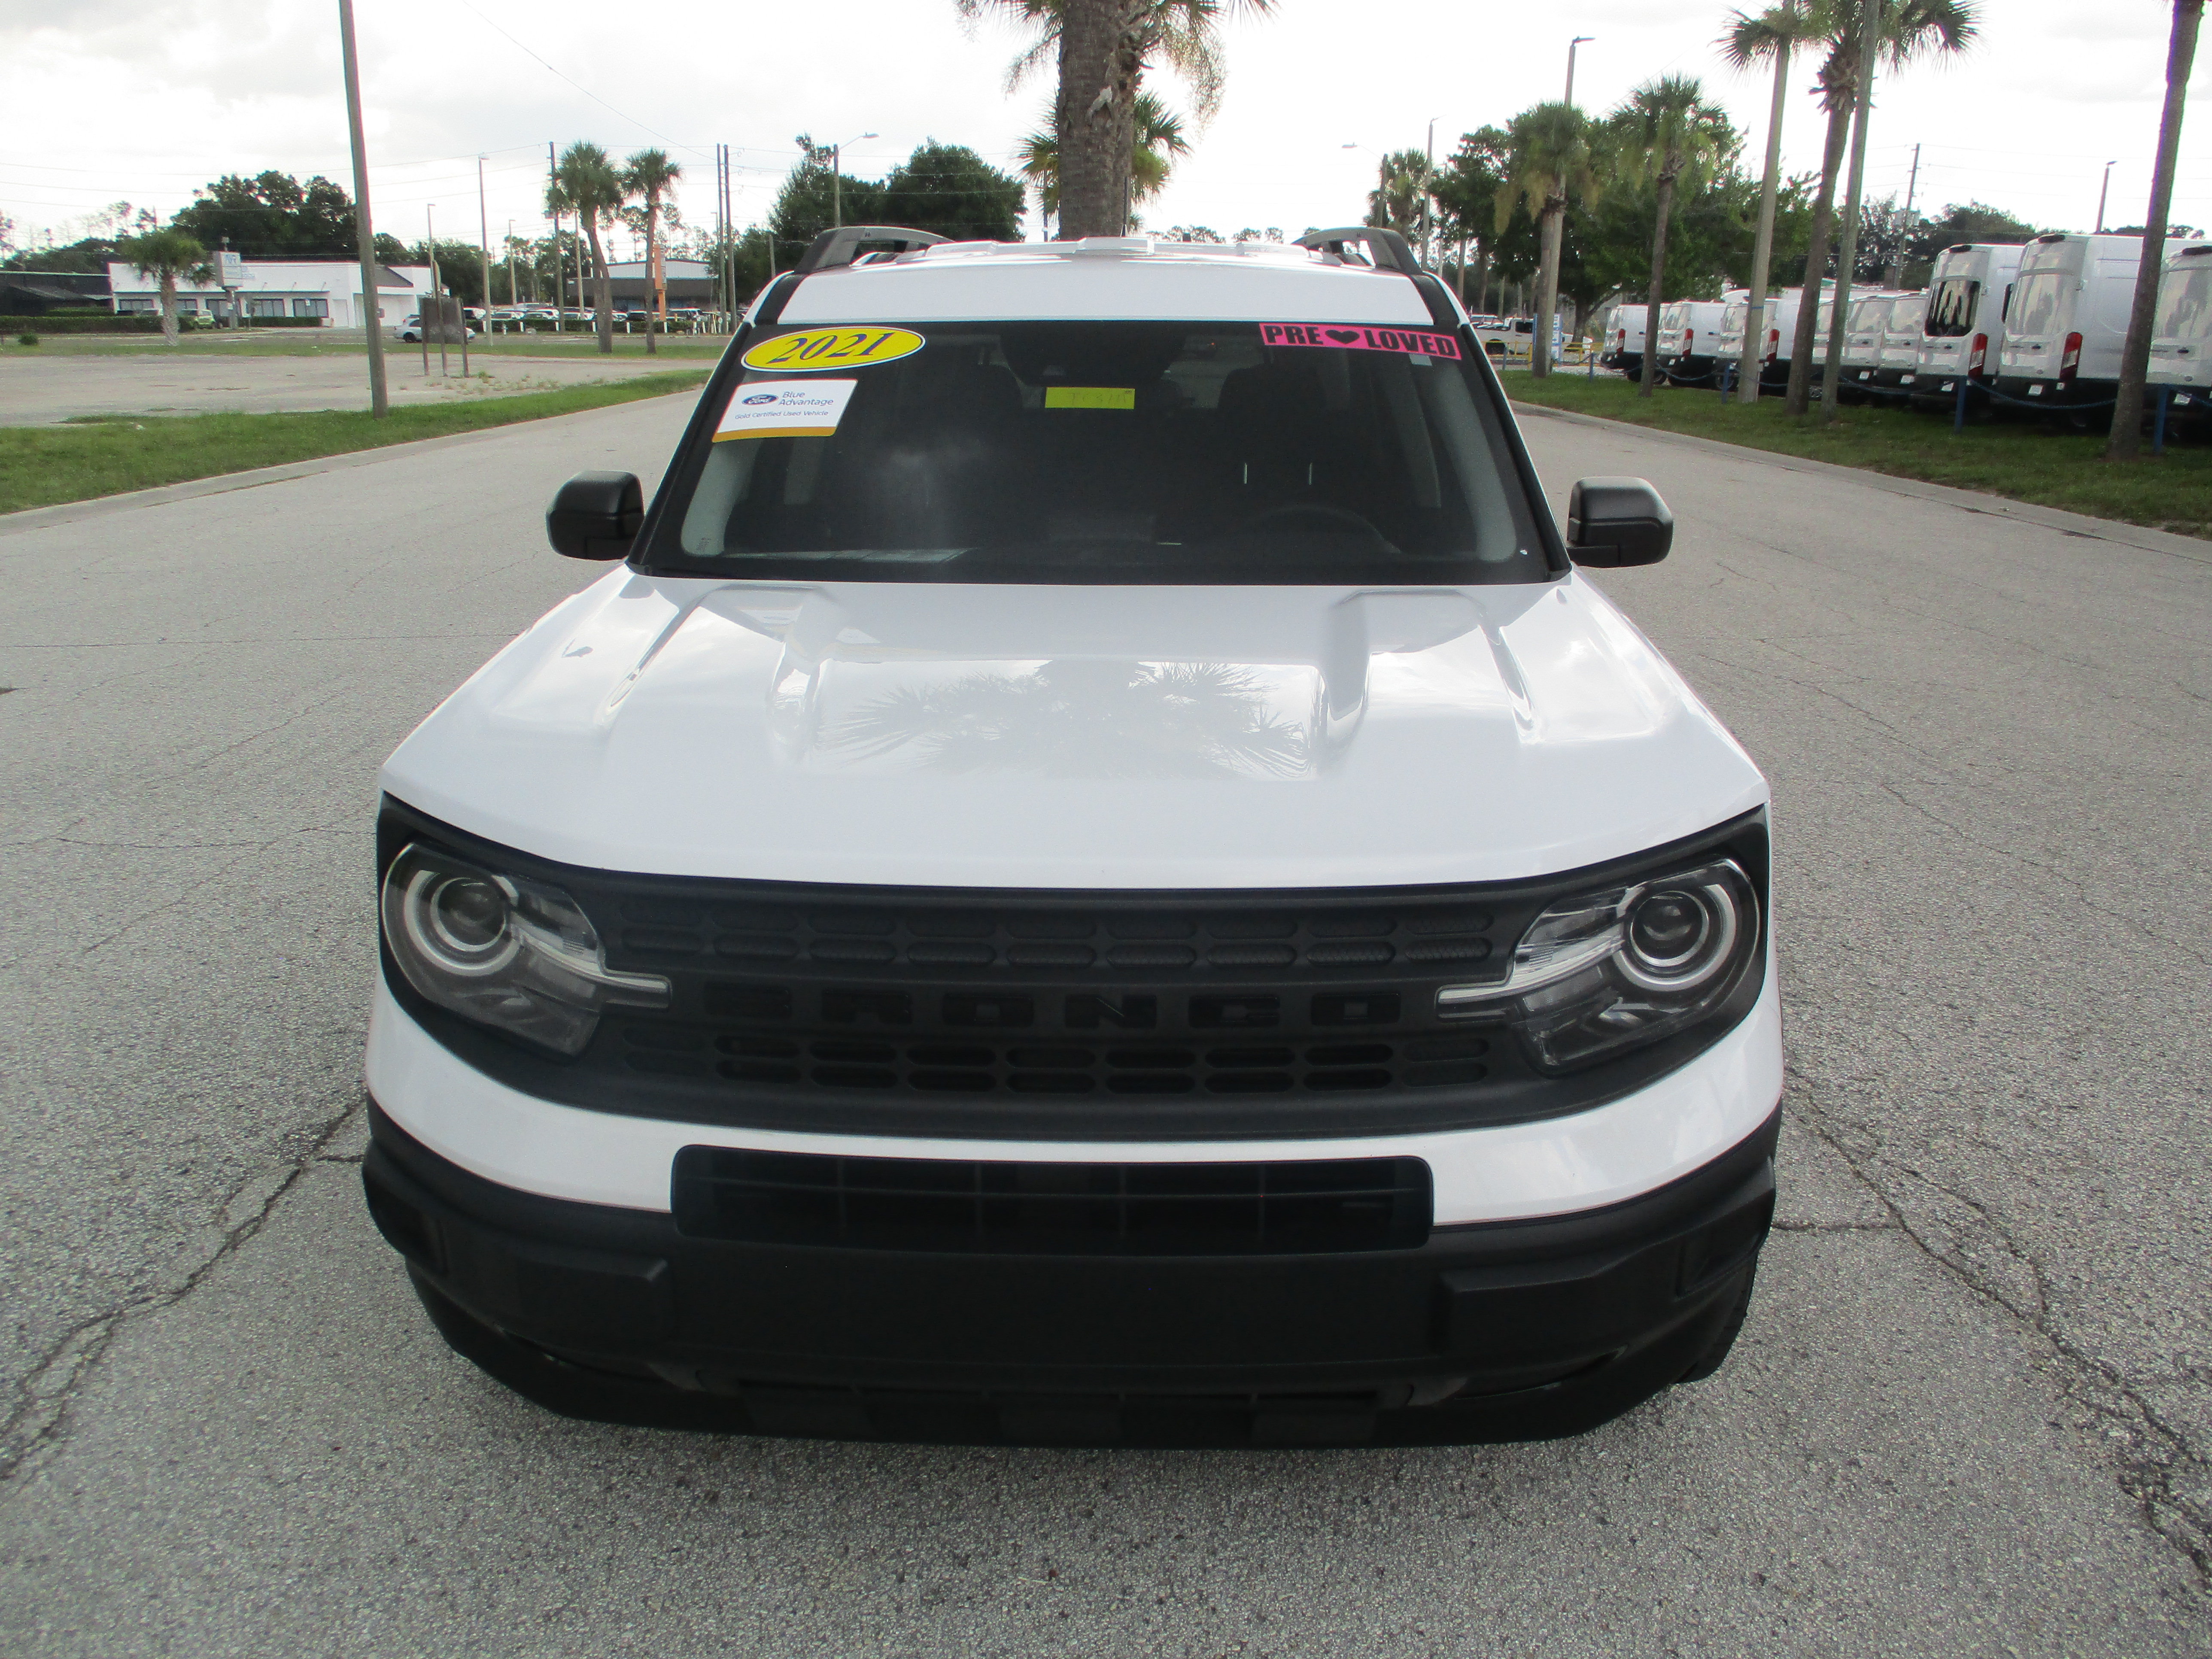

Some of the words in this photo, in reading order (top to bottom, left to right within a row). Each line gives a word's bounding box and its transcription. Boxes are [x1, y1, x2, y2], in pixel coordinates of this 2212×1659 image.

[765, 331, 896, 365] 2021
[1263, 325, 1324, 345] PRE
[1363, 329, 1457, 357] LOVED
[778, 398, 834, 407] Advantage
